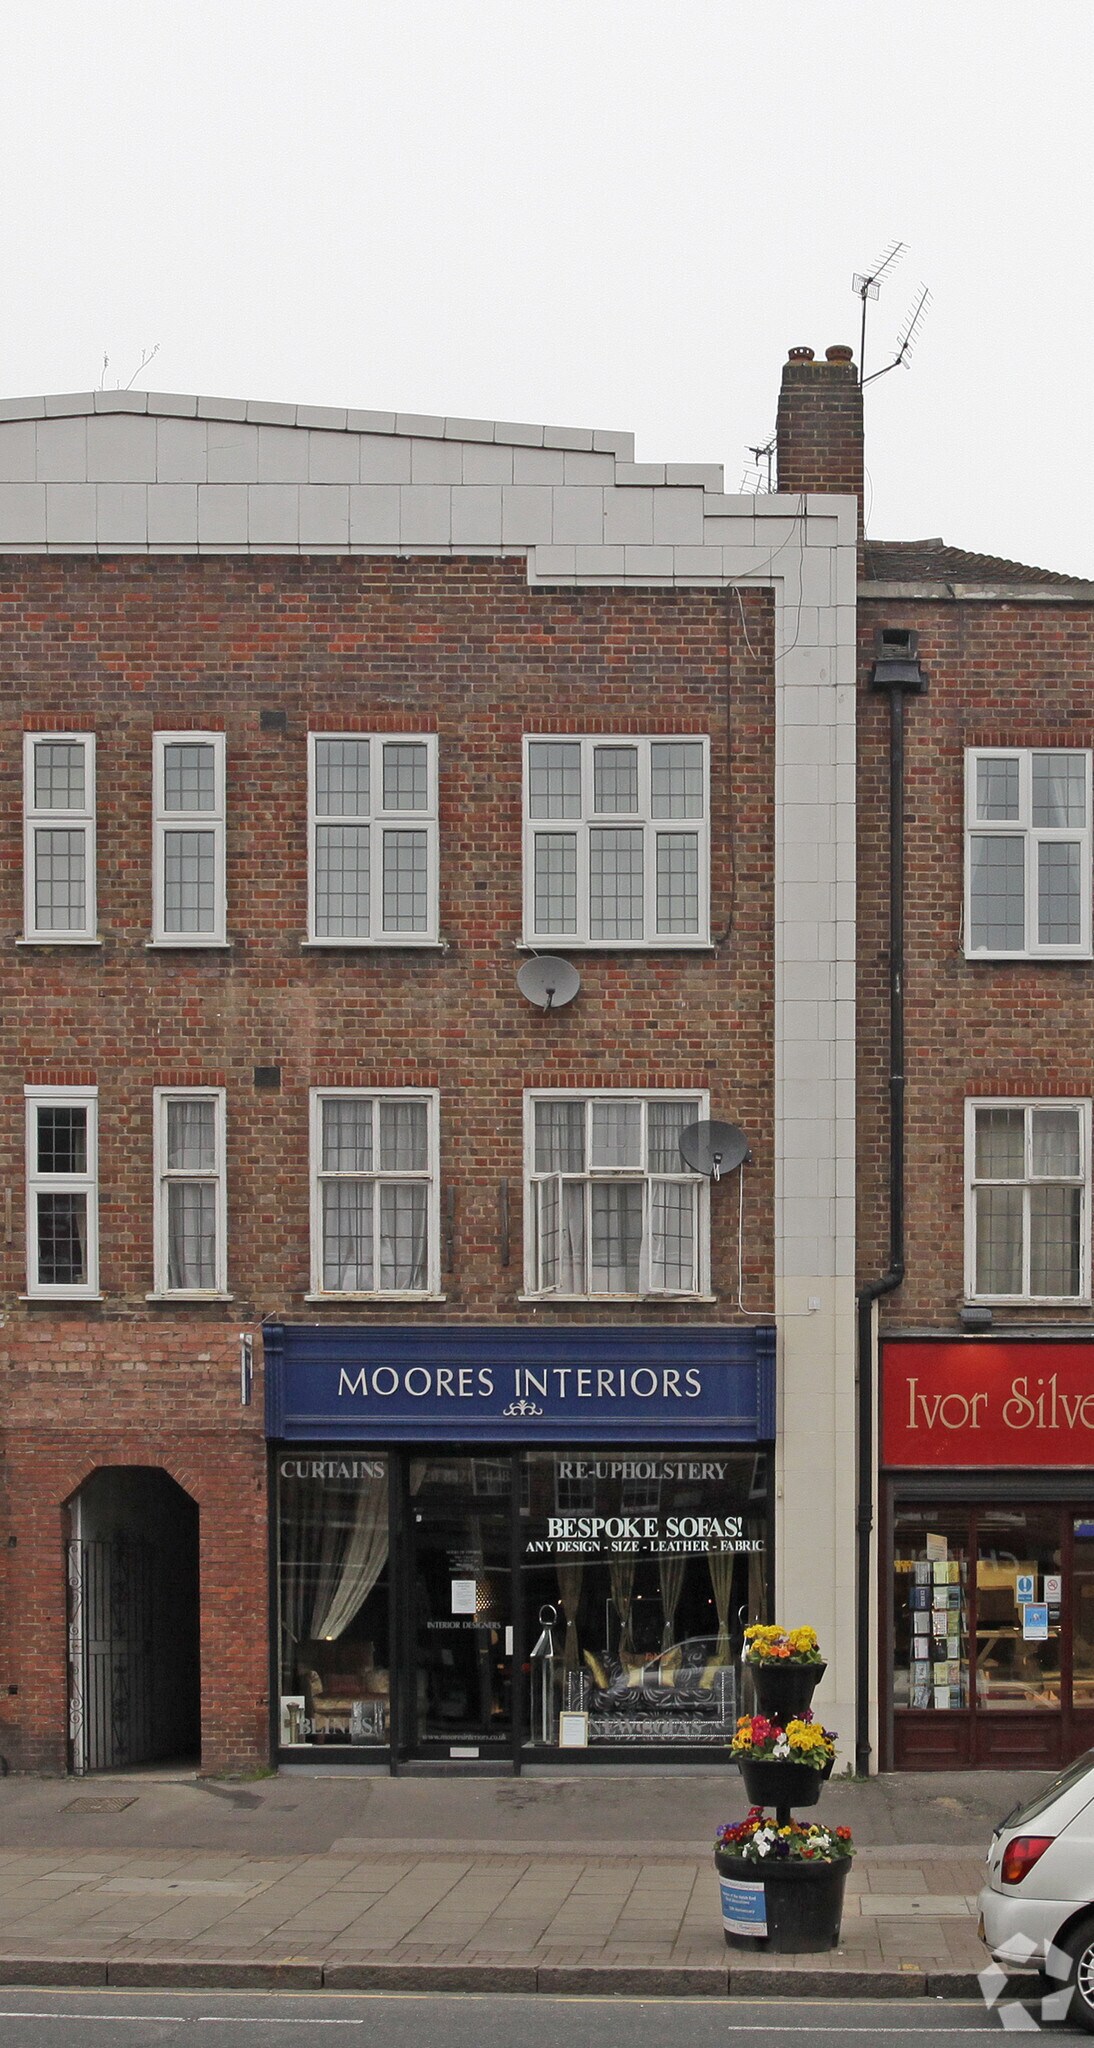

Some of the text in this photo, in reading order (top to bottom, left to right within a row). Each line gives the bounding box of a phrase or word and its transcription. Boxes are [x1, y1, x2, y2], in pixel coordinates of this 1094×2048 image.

[338, 1367, 702, 1398] MOORES INTERIORS
[906, 1377, 988, 1429] Ivor
[280, 1461, 385, 1478] CURTAINS
[559, 1462, 728, 1480] RE-UPHOLSTERY
[547, 1517, 743, 1538] BESPOKE SOFAS!
[526, 1541, 554, 1552] ANY
[556, 1541, 600, 1552] DESIGN
[611, 1541, 640, 1552] SIZE
[650, 1540, 710, 1551] LEATHER
[720, 1540, 765, 1551] FABRIC
[427, 1621, 501, 1629] INTERIOR DESIGNERS
[300, 1718, 373, 1735] BLINDS
[642, 1717, 703, 1735] SOFAS
